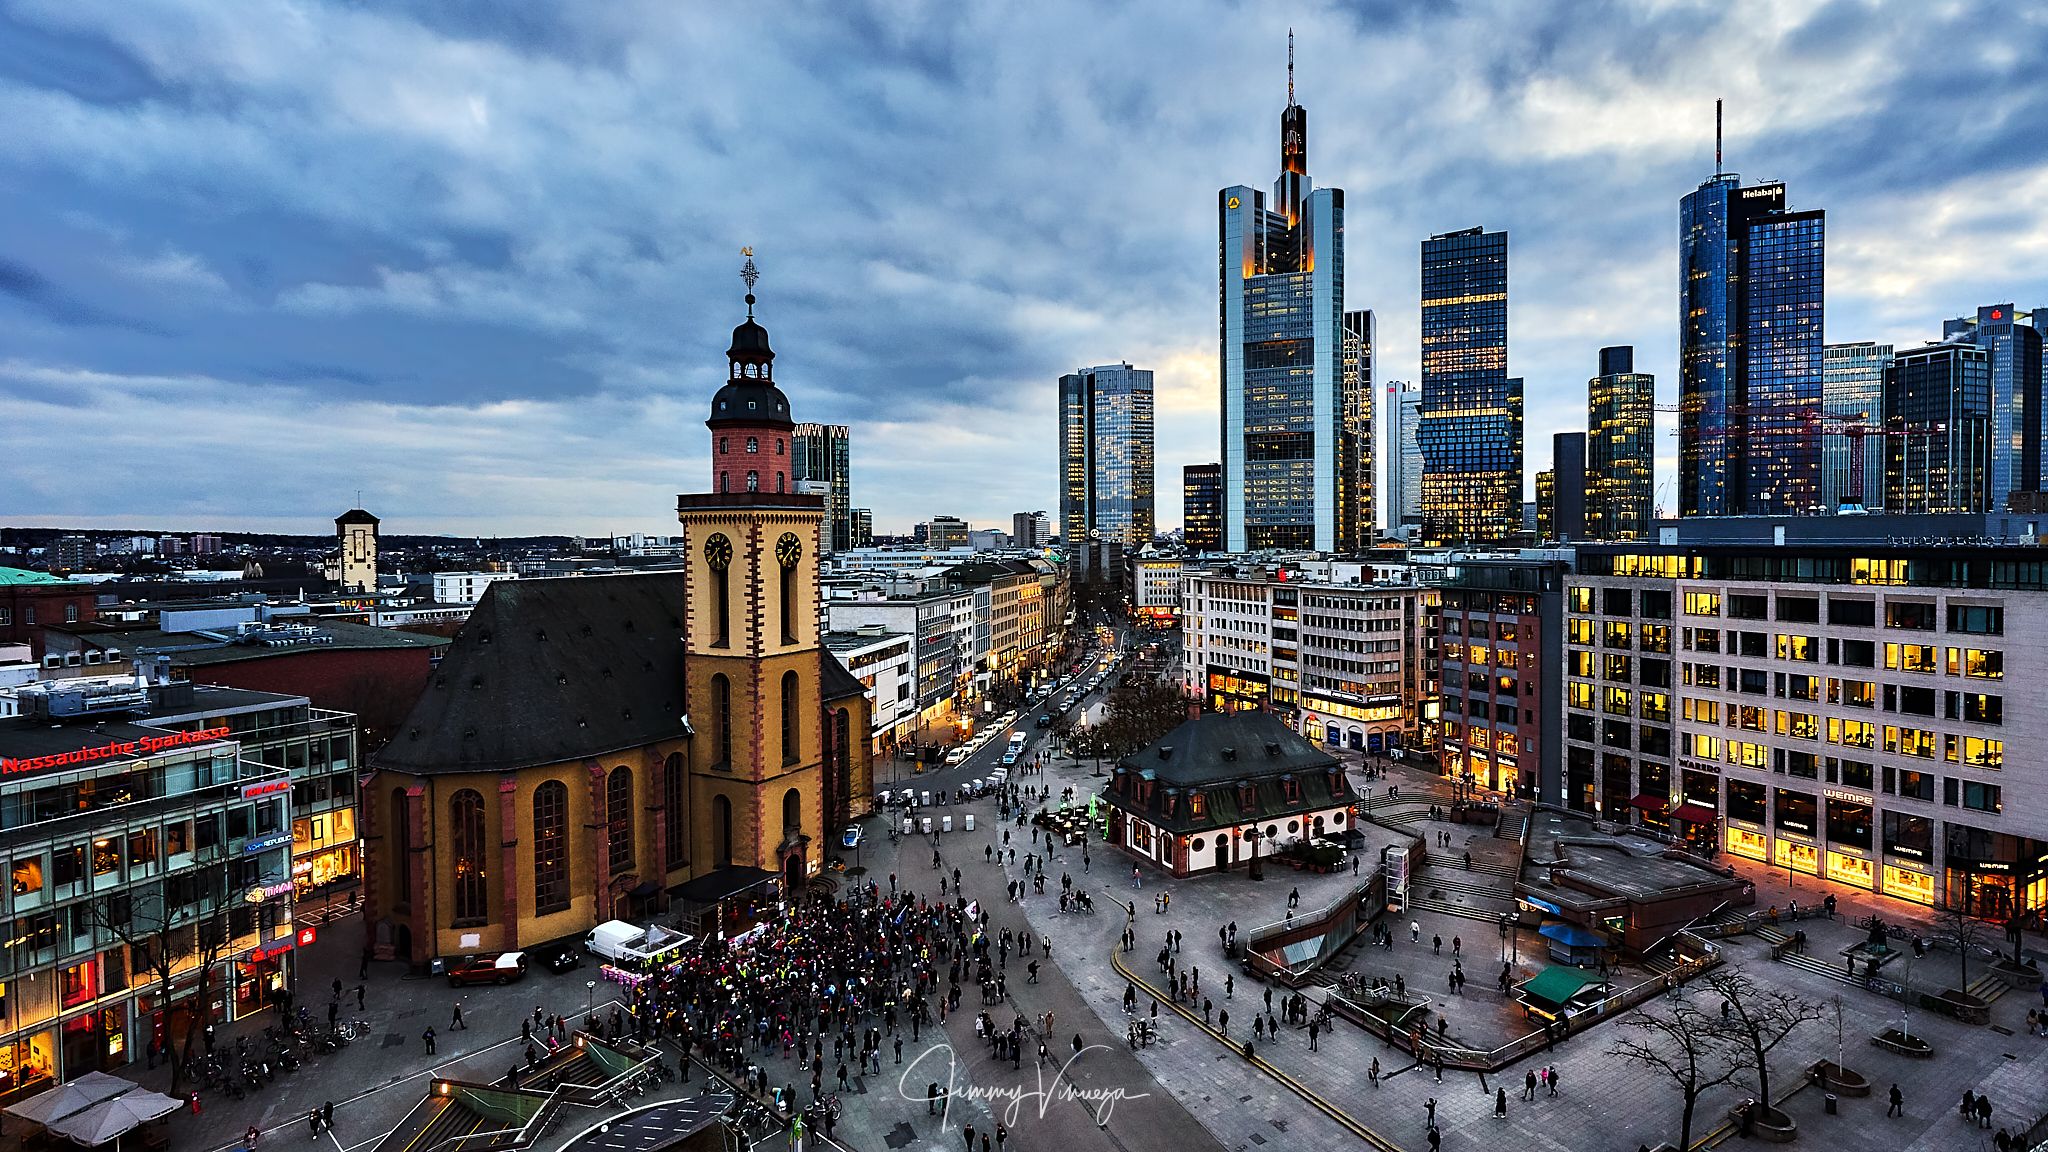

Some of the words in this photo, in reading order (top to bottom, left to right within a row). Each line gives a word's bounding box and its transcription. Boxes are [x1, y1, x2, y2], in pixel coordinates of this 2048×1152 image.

[1742, 188, 1773, 199] Helaba
[0, 741, 135, 775] Nassauische
[139, 726, 231, 753] Sparkasse
[1823, 788, 1874, 805] WEMPE
[1893, 845, 1923, 857] WEMPE
